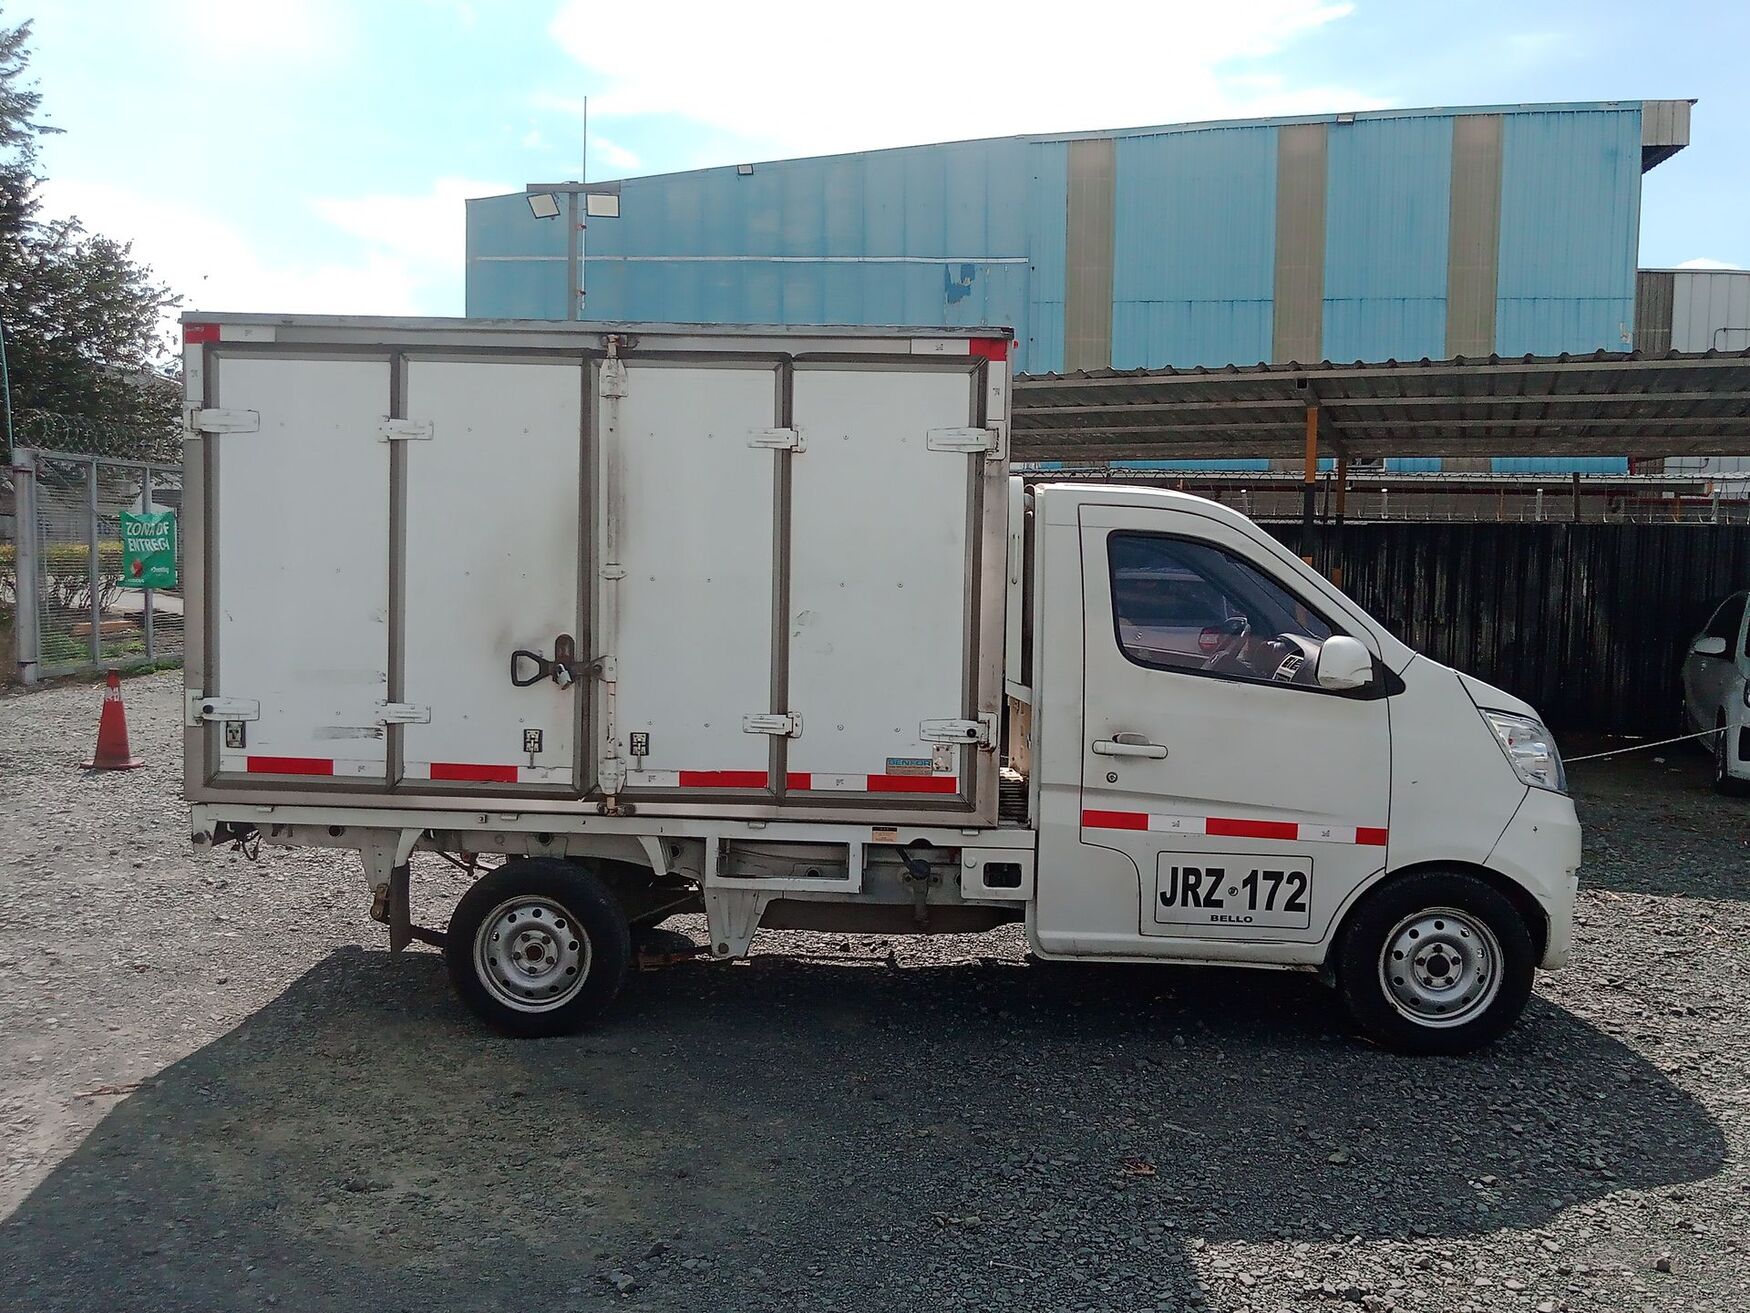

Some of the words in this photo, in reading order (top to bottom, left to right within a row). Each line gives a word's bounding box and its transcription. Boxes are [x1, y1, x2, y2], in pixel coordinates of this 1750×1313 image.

[125, 521, 155, 536] ZONA
[1159, 866, 1226, 909] JRZ
[1241, 869, 1308, 913] 172
[1210, 914, 1254, 924] BELLO
